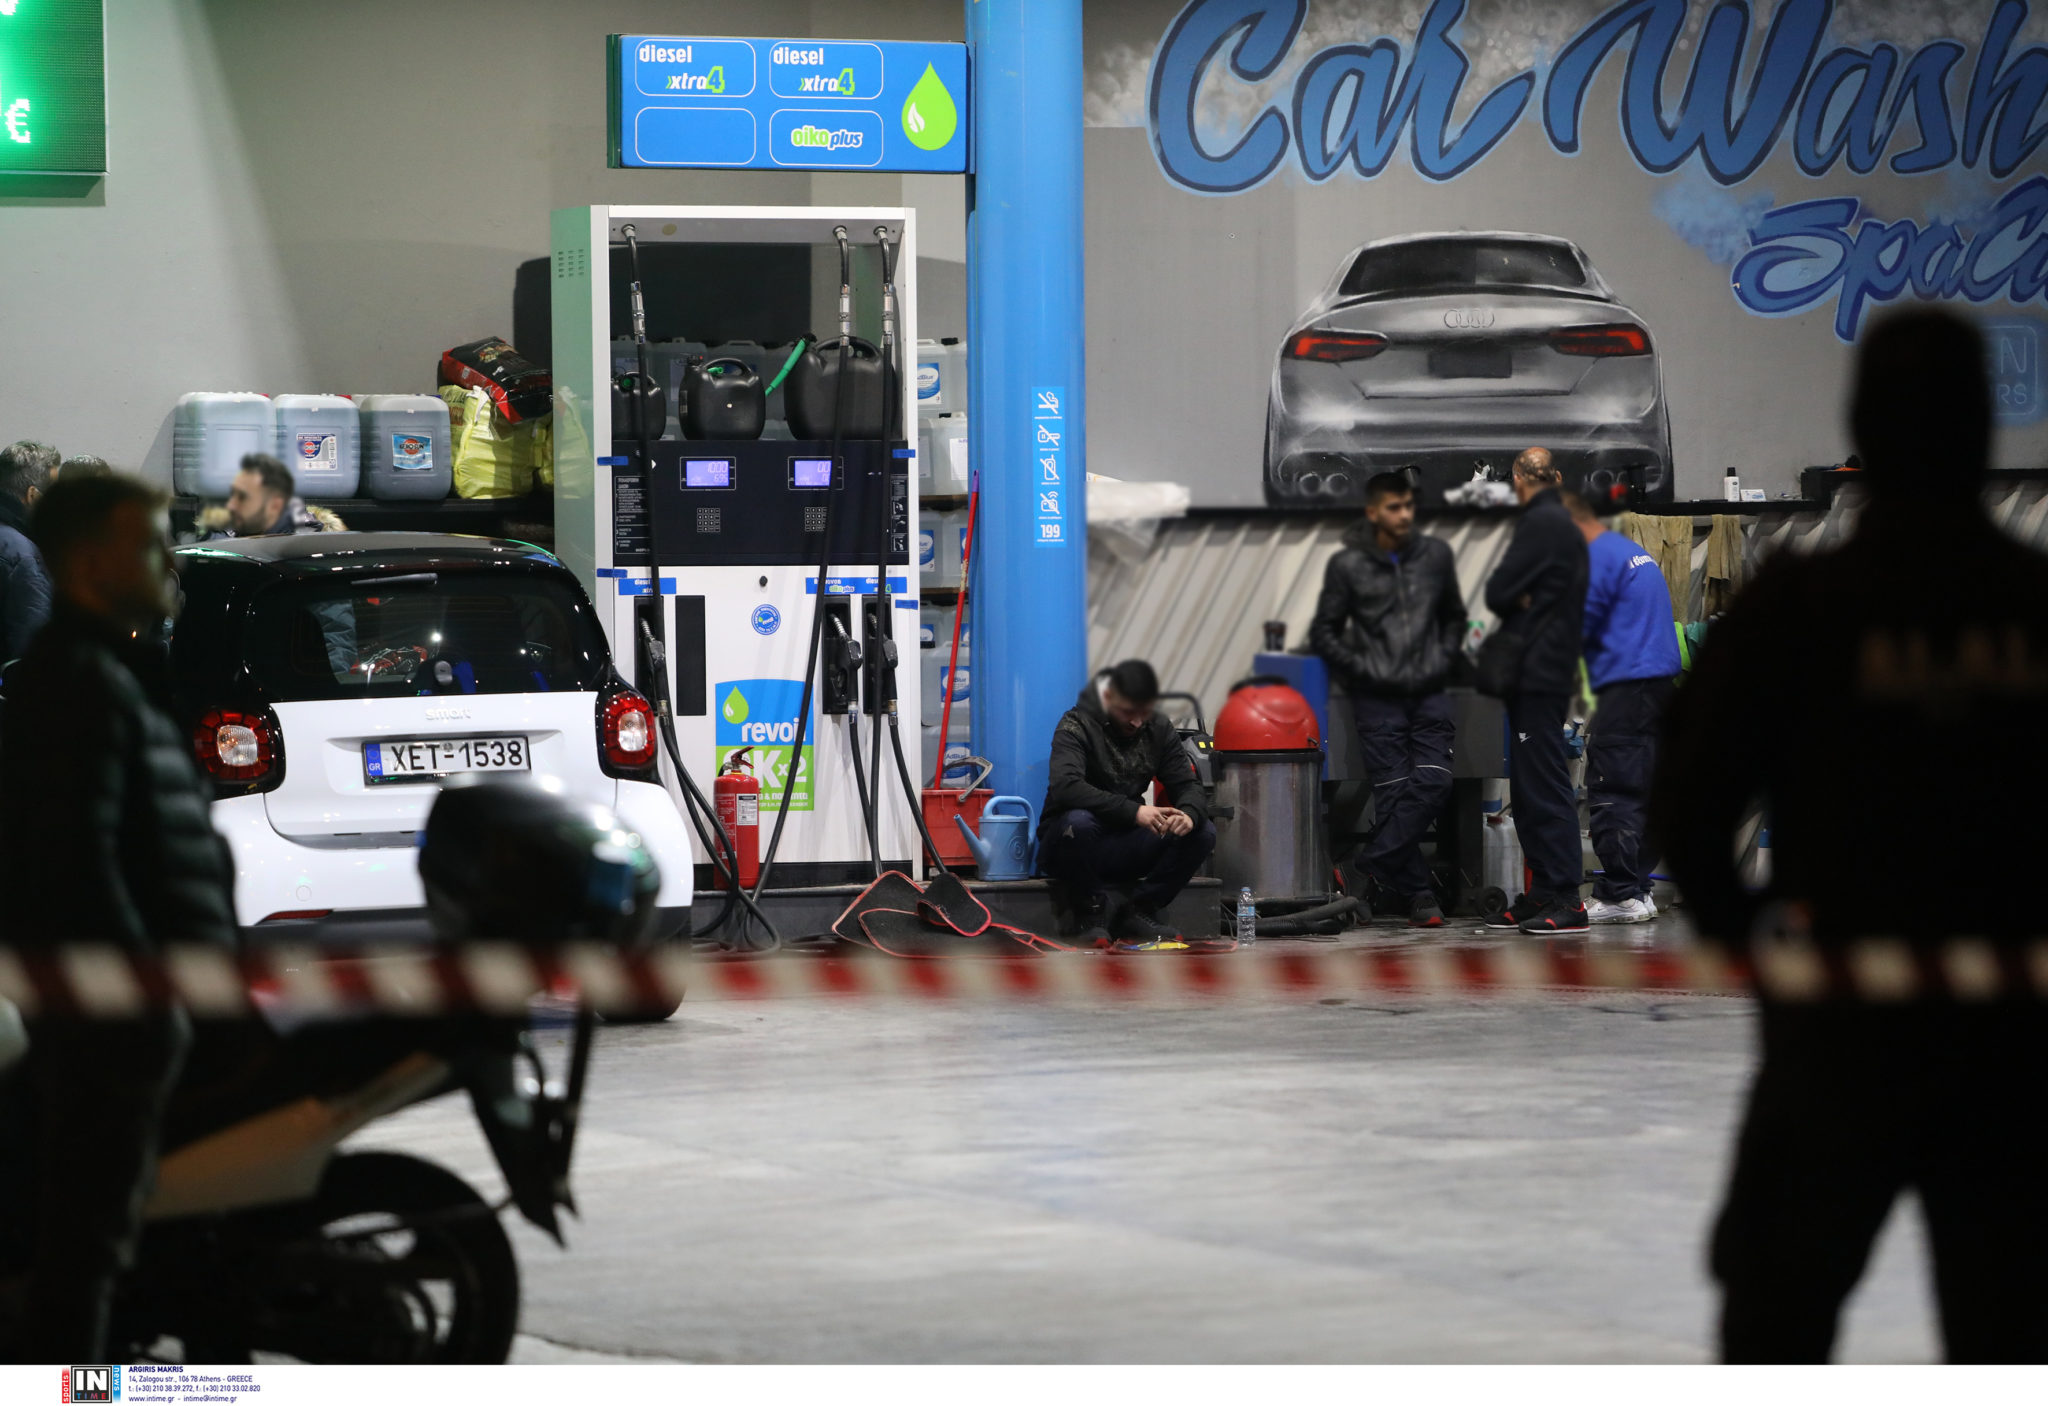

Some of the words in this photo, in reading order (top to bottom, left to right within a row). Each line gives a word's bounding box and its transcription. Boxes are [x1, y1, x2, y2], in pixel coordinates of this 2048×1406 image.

[639, 45, 693, 63] diesel
[773, 48, 824, 65] diesel
[1146, 0, 1537, 194] Car
[1542, 0, 2048, 187] Wash
[1040, 524, 1060, 538] 199
[425, 706, 472, 721] smart
[391, 740, 523, 771] XET-1538
[368, 762, 381, 771] GR
